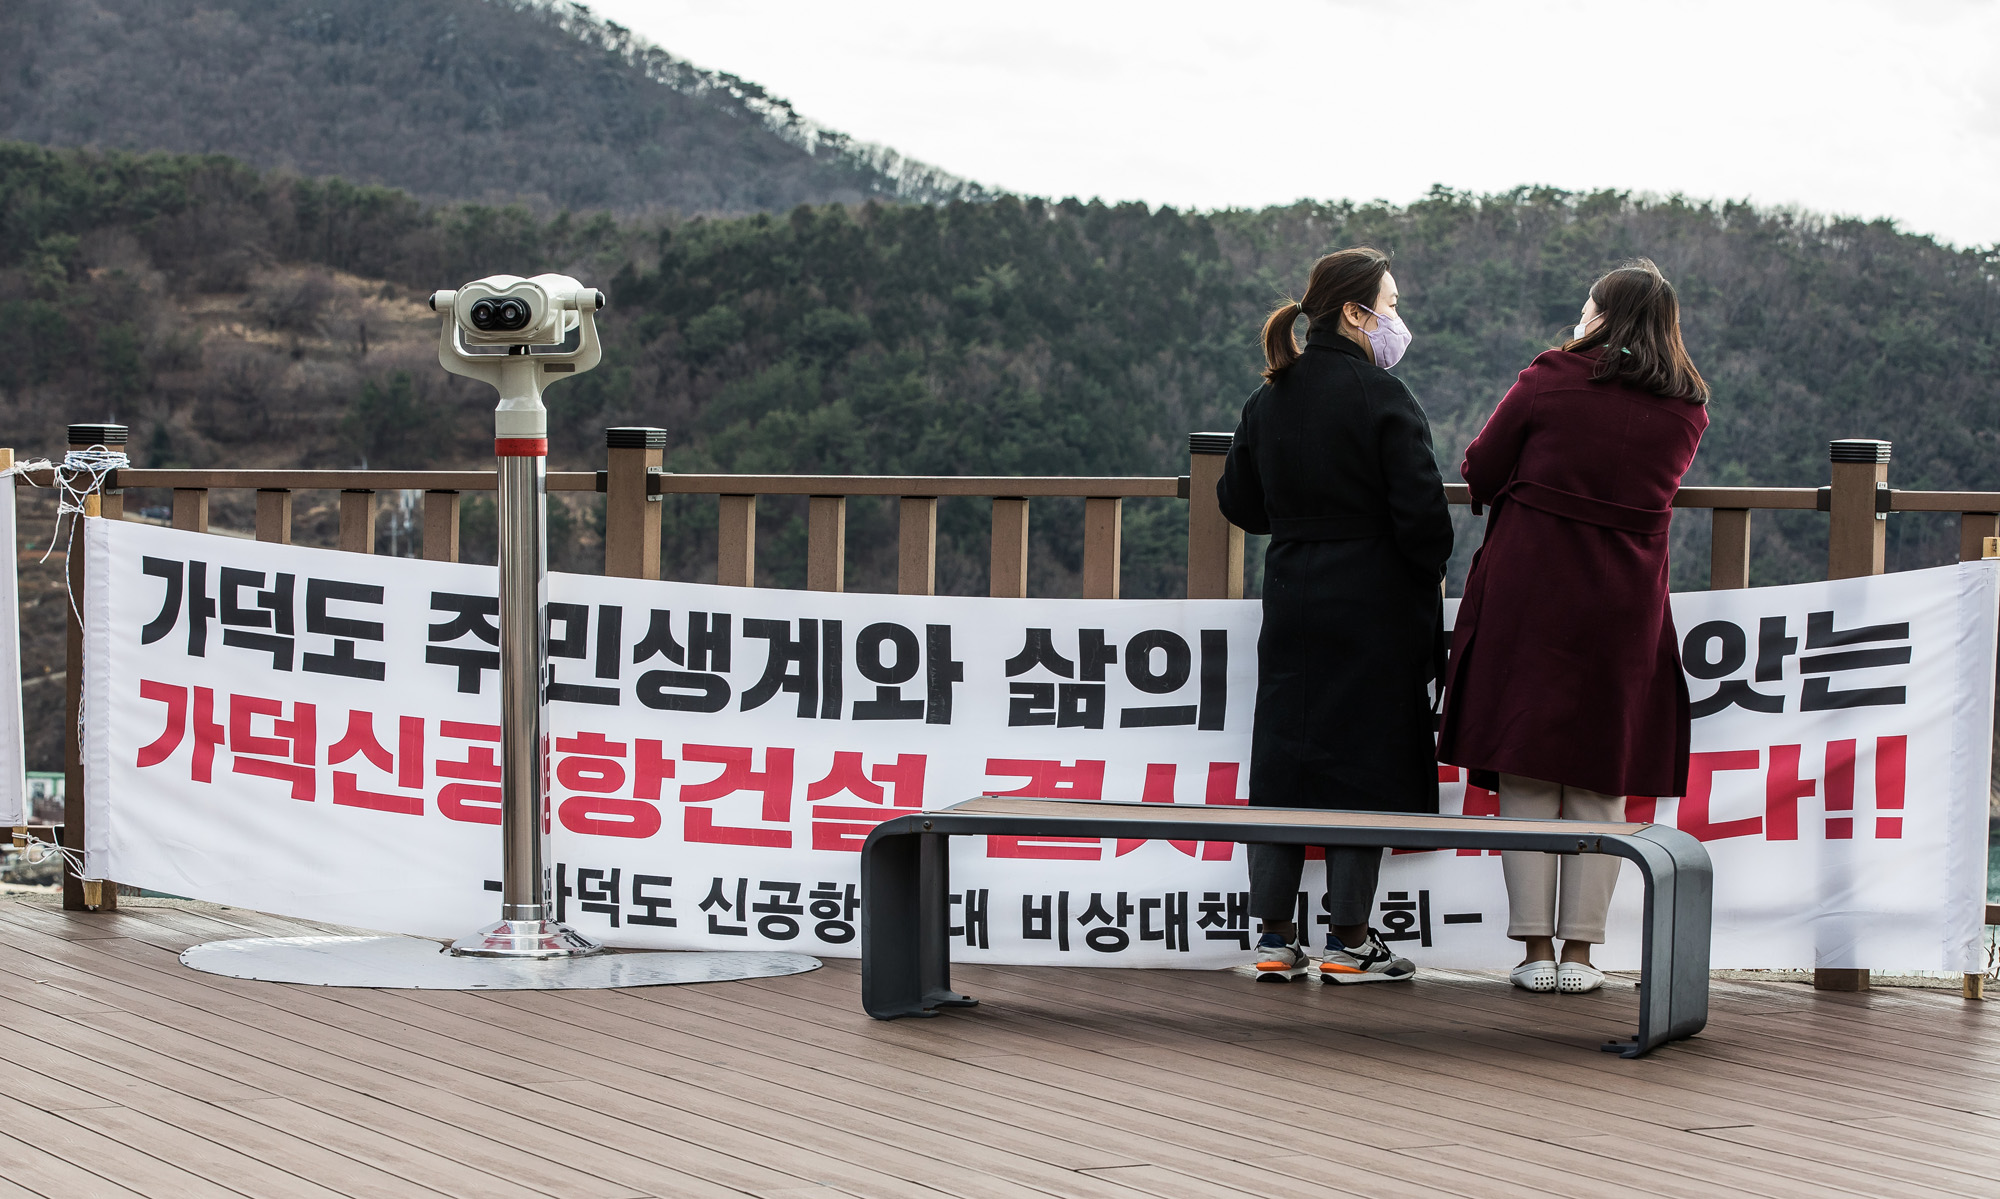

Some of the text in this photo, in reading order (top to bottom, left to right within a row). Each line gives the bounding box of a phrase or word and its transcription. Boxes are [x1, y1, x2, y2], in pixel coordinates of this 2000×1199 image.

[141, 556, 1911, 731] 가덕도 주민생계와 삶의 앗는
[136, 681, 928, 853] 가덕신공항건설
[698, 877, 861, 944] 신공항
